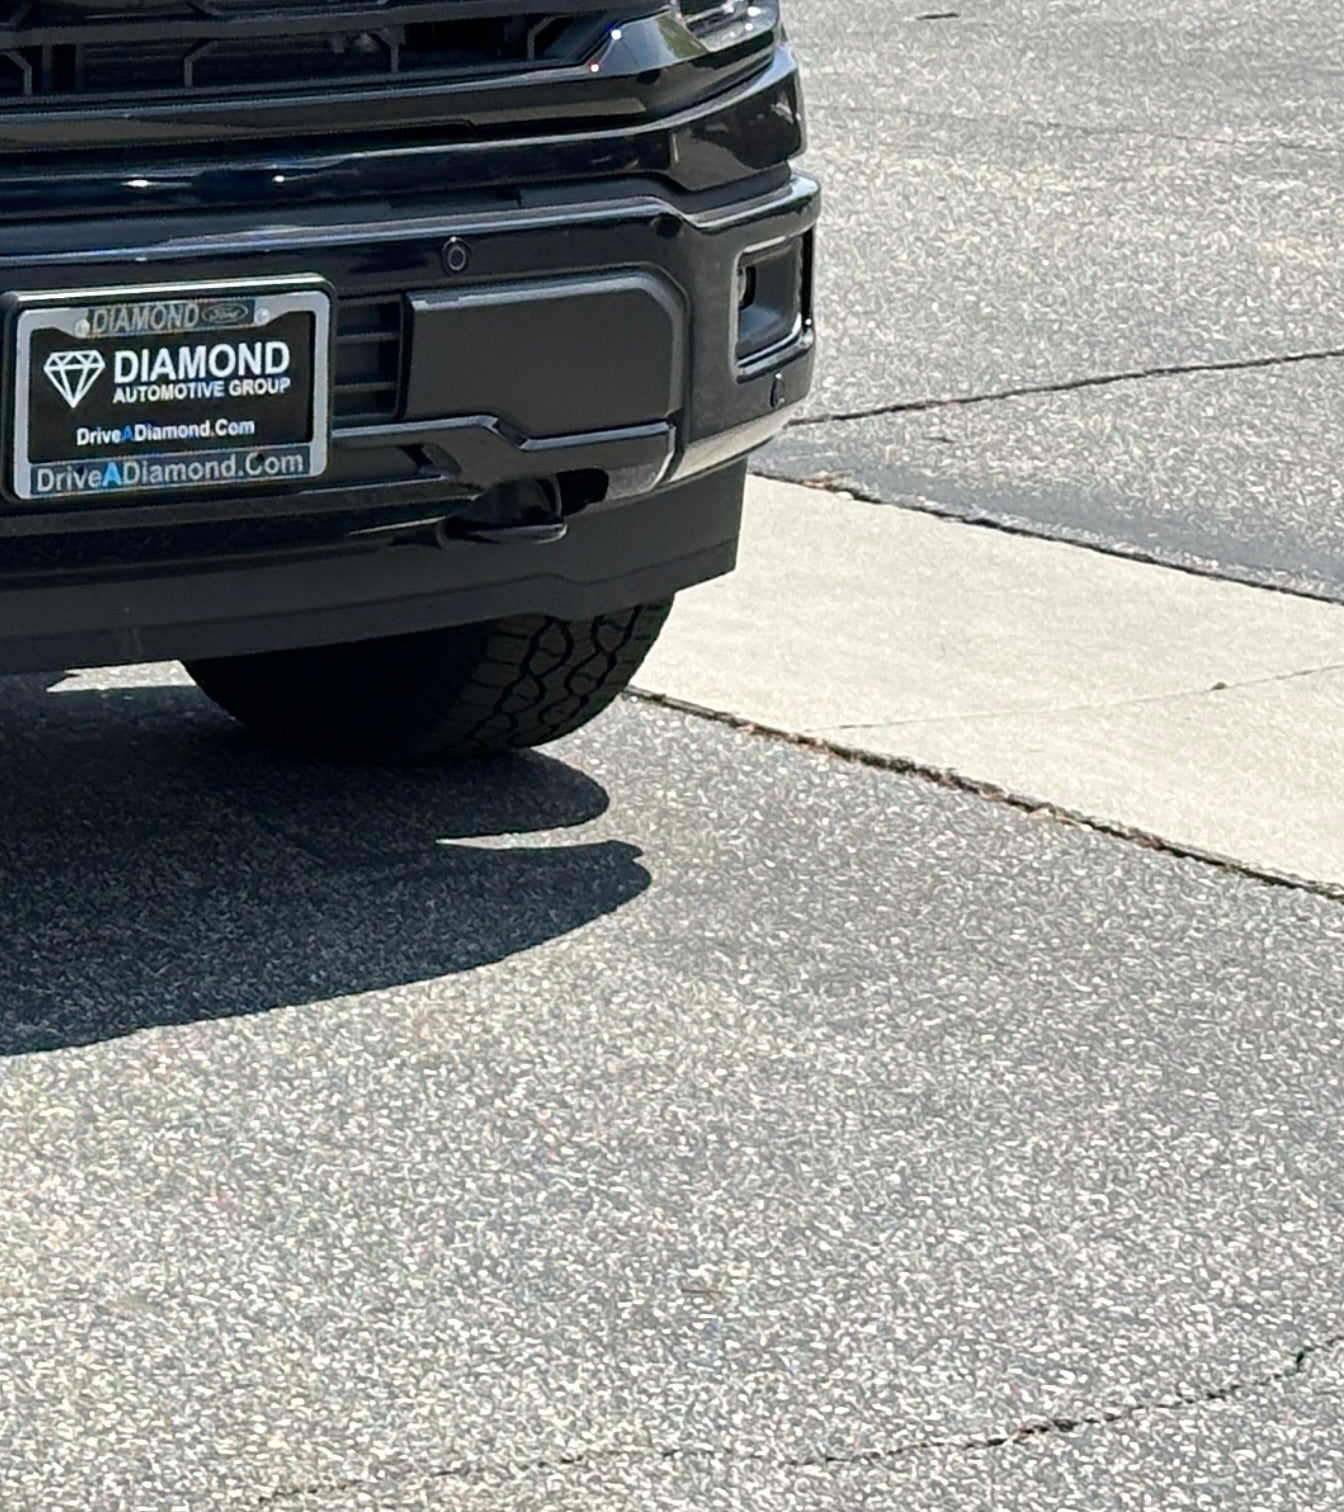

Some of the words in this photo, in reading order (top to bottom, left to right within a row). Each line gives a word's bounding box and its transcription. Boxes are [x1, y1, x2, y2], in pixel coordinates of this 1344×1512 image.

[92, 302, 200, 334] DIAMOND
[113, 341, 290, 385] DIAMOND
[112, 382, 225, 404] AUTOMOTIVE
[228, 376, 291, 397] GROUP
[76, 417, 255, 446] DriveADiamond.Com
[36, 452, 304, 493] DriveADiamond.Com
